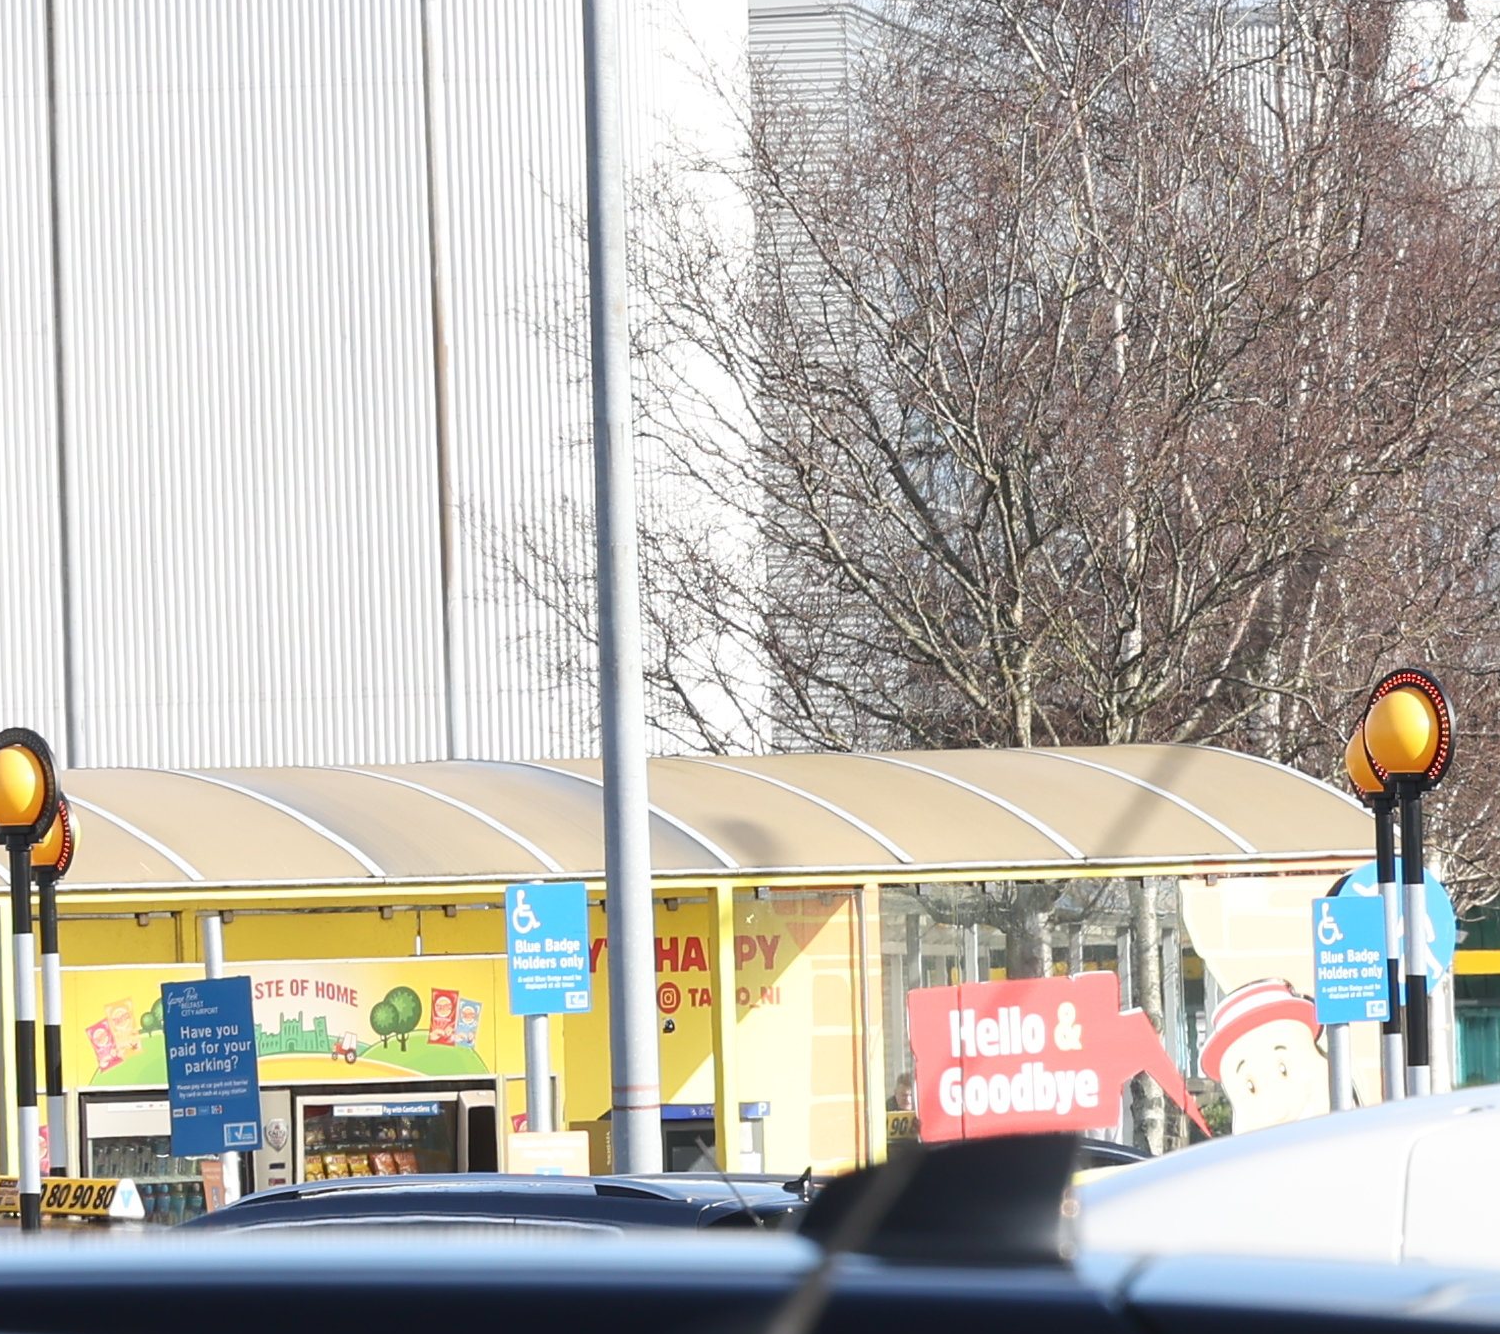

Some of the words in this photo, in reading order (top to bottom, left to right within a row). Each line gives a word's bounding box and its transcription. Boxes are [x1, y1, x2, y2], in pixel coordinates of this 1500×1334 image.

[515, 939, 541, 954] Blue
[545, 938, 580, 954] Badge
[655, 935, 780, 972] HAPY
[513, 956, 557, 970] Holders
[560, 954, 584, 970] only
[1321, 951, 1344, 964] Blue
[1347, 949, 1380, 964] Badge
[1318, 966, 1358, 980] Holders
[1361, 965, 1383, 979] only
[255, 979, 284, 1000] STE
[290, 978, 309, 996] OF
[315, 980, 358, 1008] HOME
[688, 987, 781, 1008] TAO_NI
[181, 1009, 195, 1017] CITY
[180, 1026, 212, 1040] Have
[216, 1025, 239, 1038] you
[950, 1006, 1045, 1057] Hello
[1054, 1002, 1082, 1051] &
[170, 1042, 196, 1059] paid
[201, 1041, 219, 1055] for
[224, 1040, 251, 1056] your
[185, 1055, 239, 1075] parking?
[939, 1062, 1099, 1116] Goodbye
[46, 1183, 71, 1208] 80
[70, 1185, 94, 1209] 90
